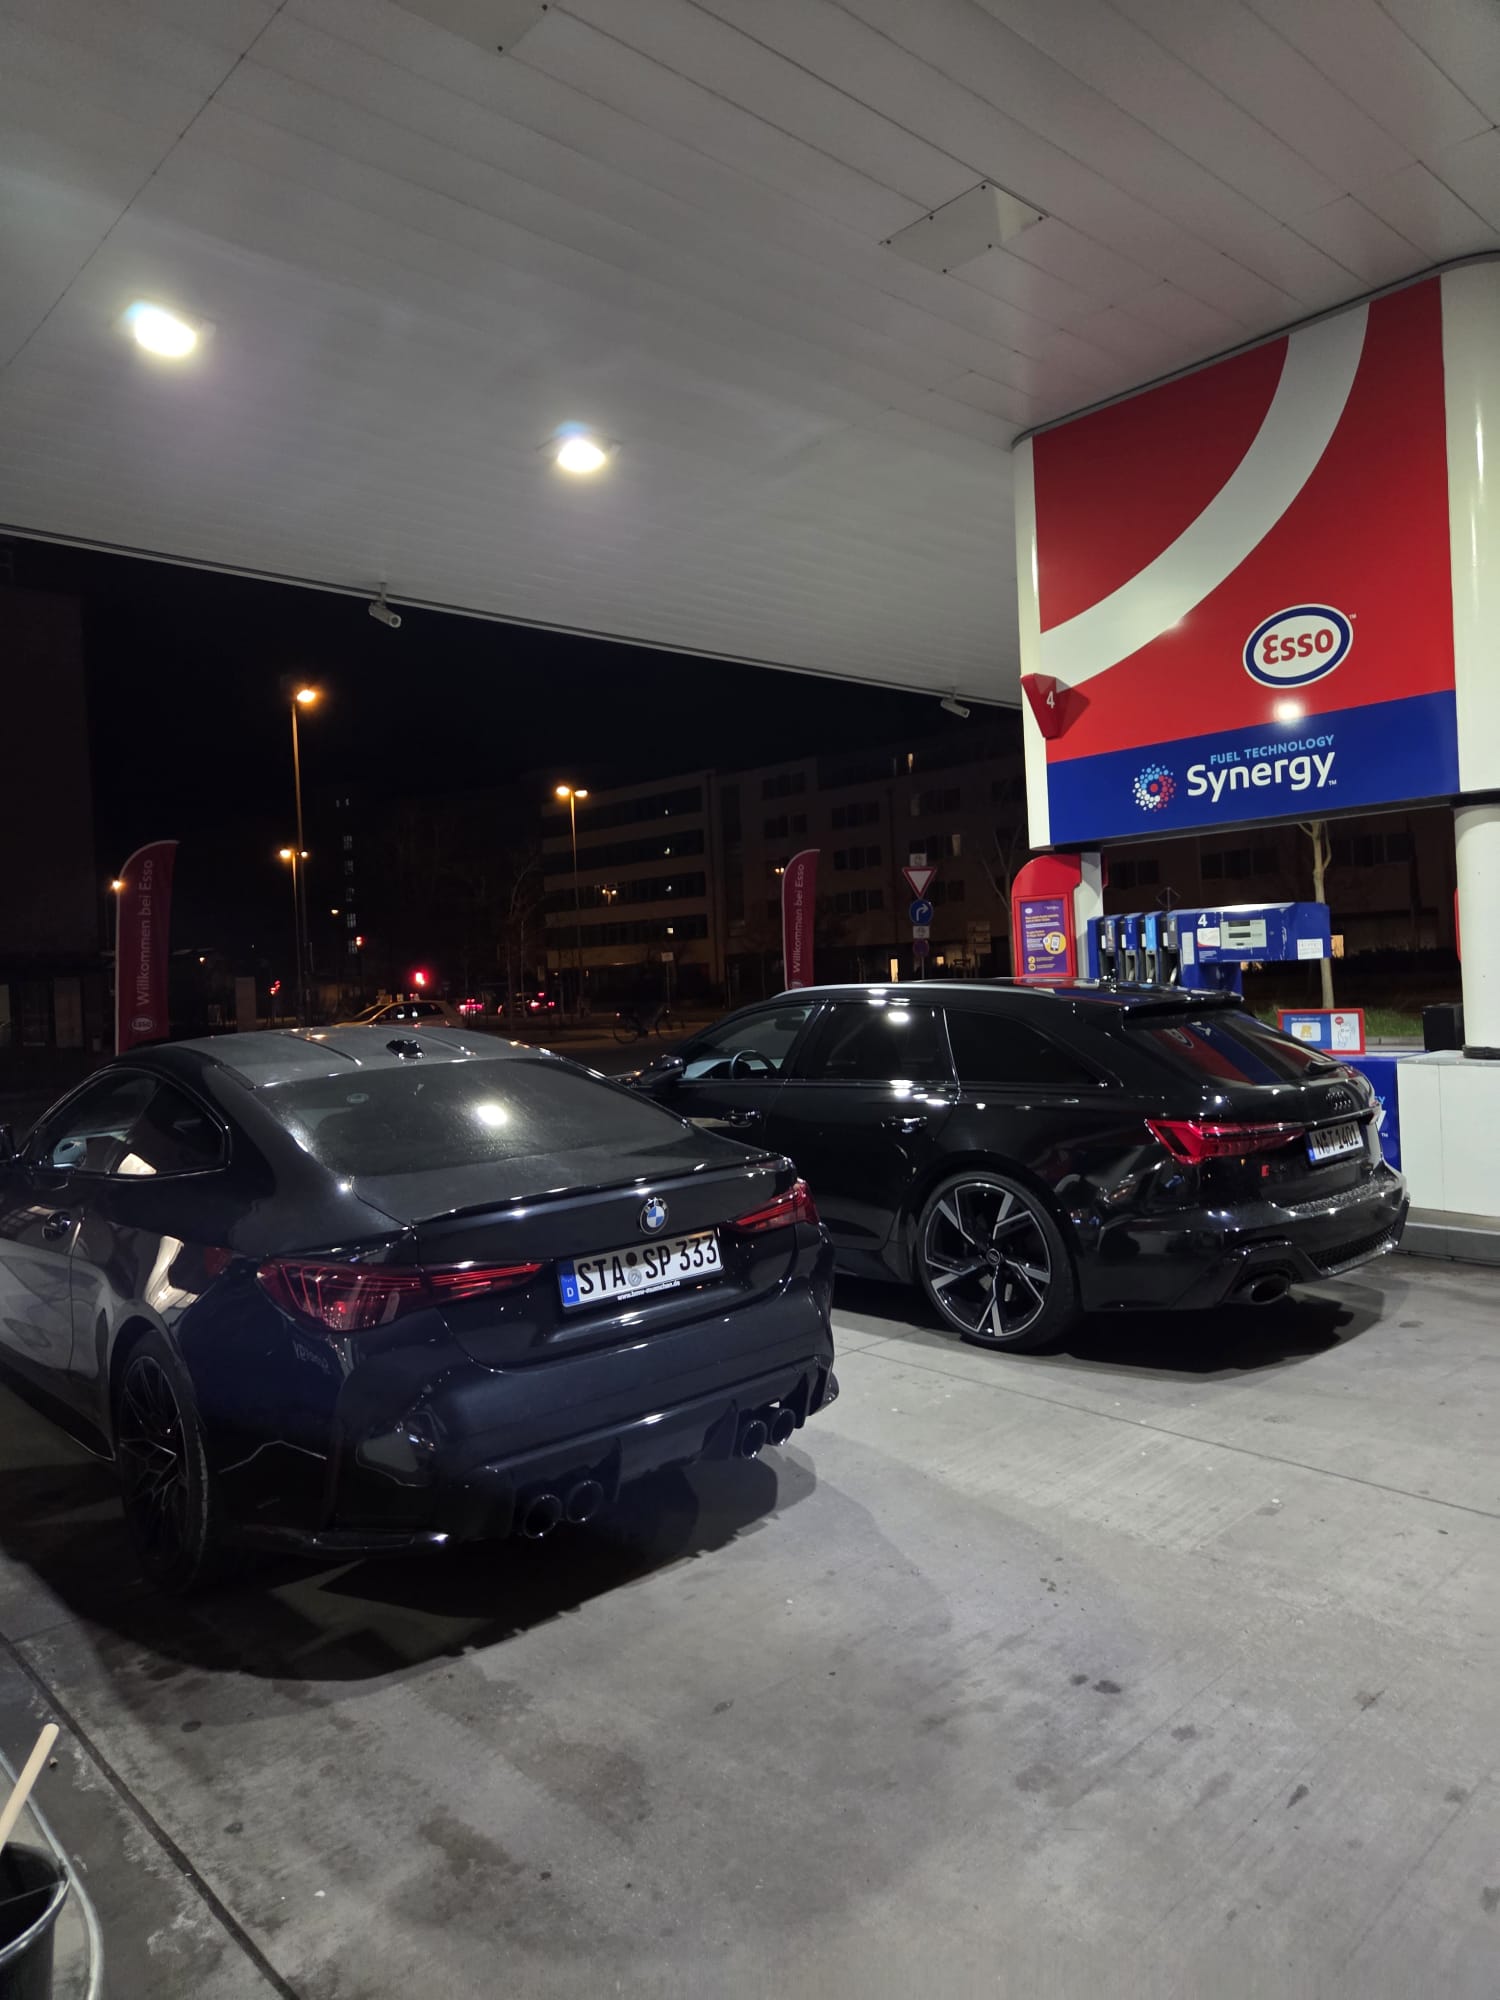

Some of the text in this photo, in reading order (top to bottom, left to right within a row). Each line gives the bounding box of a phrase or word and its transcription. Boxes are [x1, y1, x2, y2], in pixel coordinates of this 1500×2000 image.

[1261, 628, 1335, 666] Esso
[1046, 690, 1056, 709] 4
[1209, 733, 1336, 766] FUEL TECHNOLOGY
[1186, 751, 1336, 803] Synergy
[136, 859, 154, 1007] Willkommen bei Esso
[792, 863, 805, 974] Willkommen bei Esso
[1197, 913, 1209, 927] 4
[577, 1236, 717, 1295] STA SP 333
